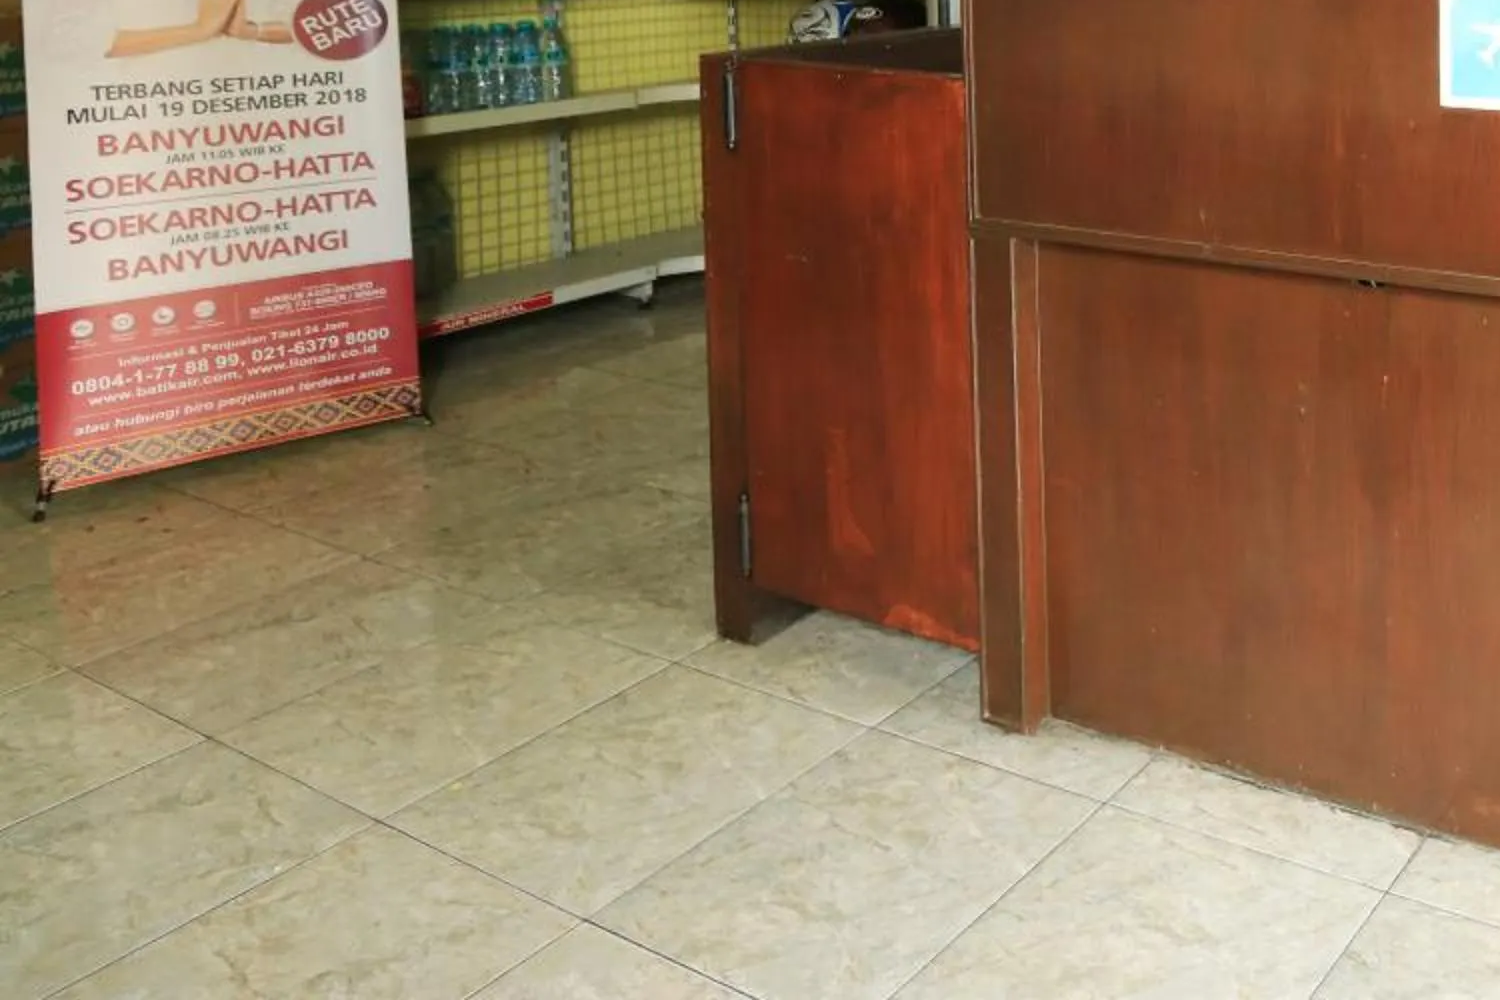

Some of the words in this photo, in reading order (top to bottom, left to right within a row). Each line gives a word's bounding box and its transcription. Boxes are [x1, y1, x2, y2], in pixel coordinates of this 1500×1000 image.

[310, 9, 382, 51] BARU
[66, 104, 147, 124] MULAI
[159, 101, 184, 117] 19
[193, 95, 308, 115] DESEMBER
[316, 88, 368, 105] 2018
[90, 79, 204, 101] TERBANG
[210, 75, 284, 94] SETIAP
[292, 71, 344, 88] HARI
[96, 115, 345, 157] BANYUWANGI
[66, 151, 375, 202] SOEKARNO-HATTA
[166, 152, 196, 164] JAM
[67, 188, 376, 244] SOEKARNO-HATTA
[108, 230, 348, 281] BANYUWANGI
[171, 233, 199, 245] JAM
[202, 334, 266, 354] Penjualan
[322, 320, 349, 333] Jam
[71, 362, 177, 395] 0804-1-77
[252, 335, 340, 362] 021-6379
[346, 327, 389, 344] 8000
[247, 343, 377, 377] www.lionair.co.id
[74, 419, 109, 437] atau
[115, 406, 181, 431] hubungi
[218, 385, 296, 412] perjalanan
[359, 364, 392, 379] anda
